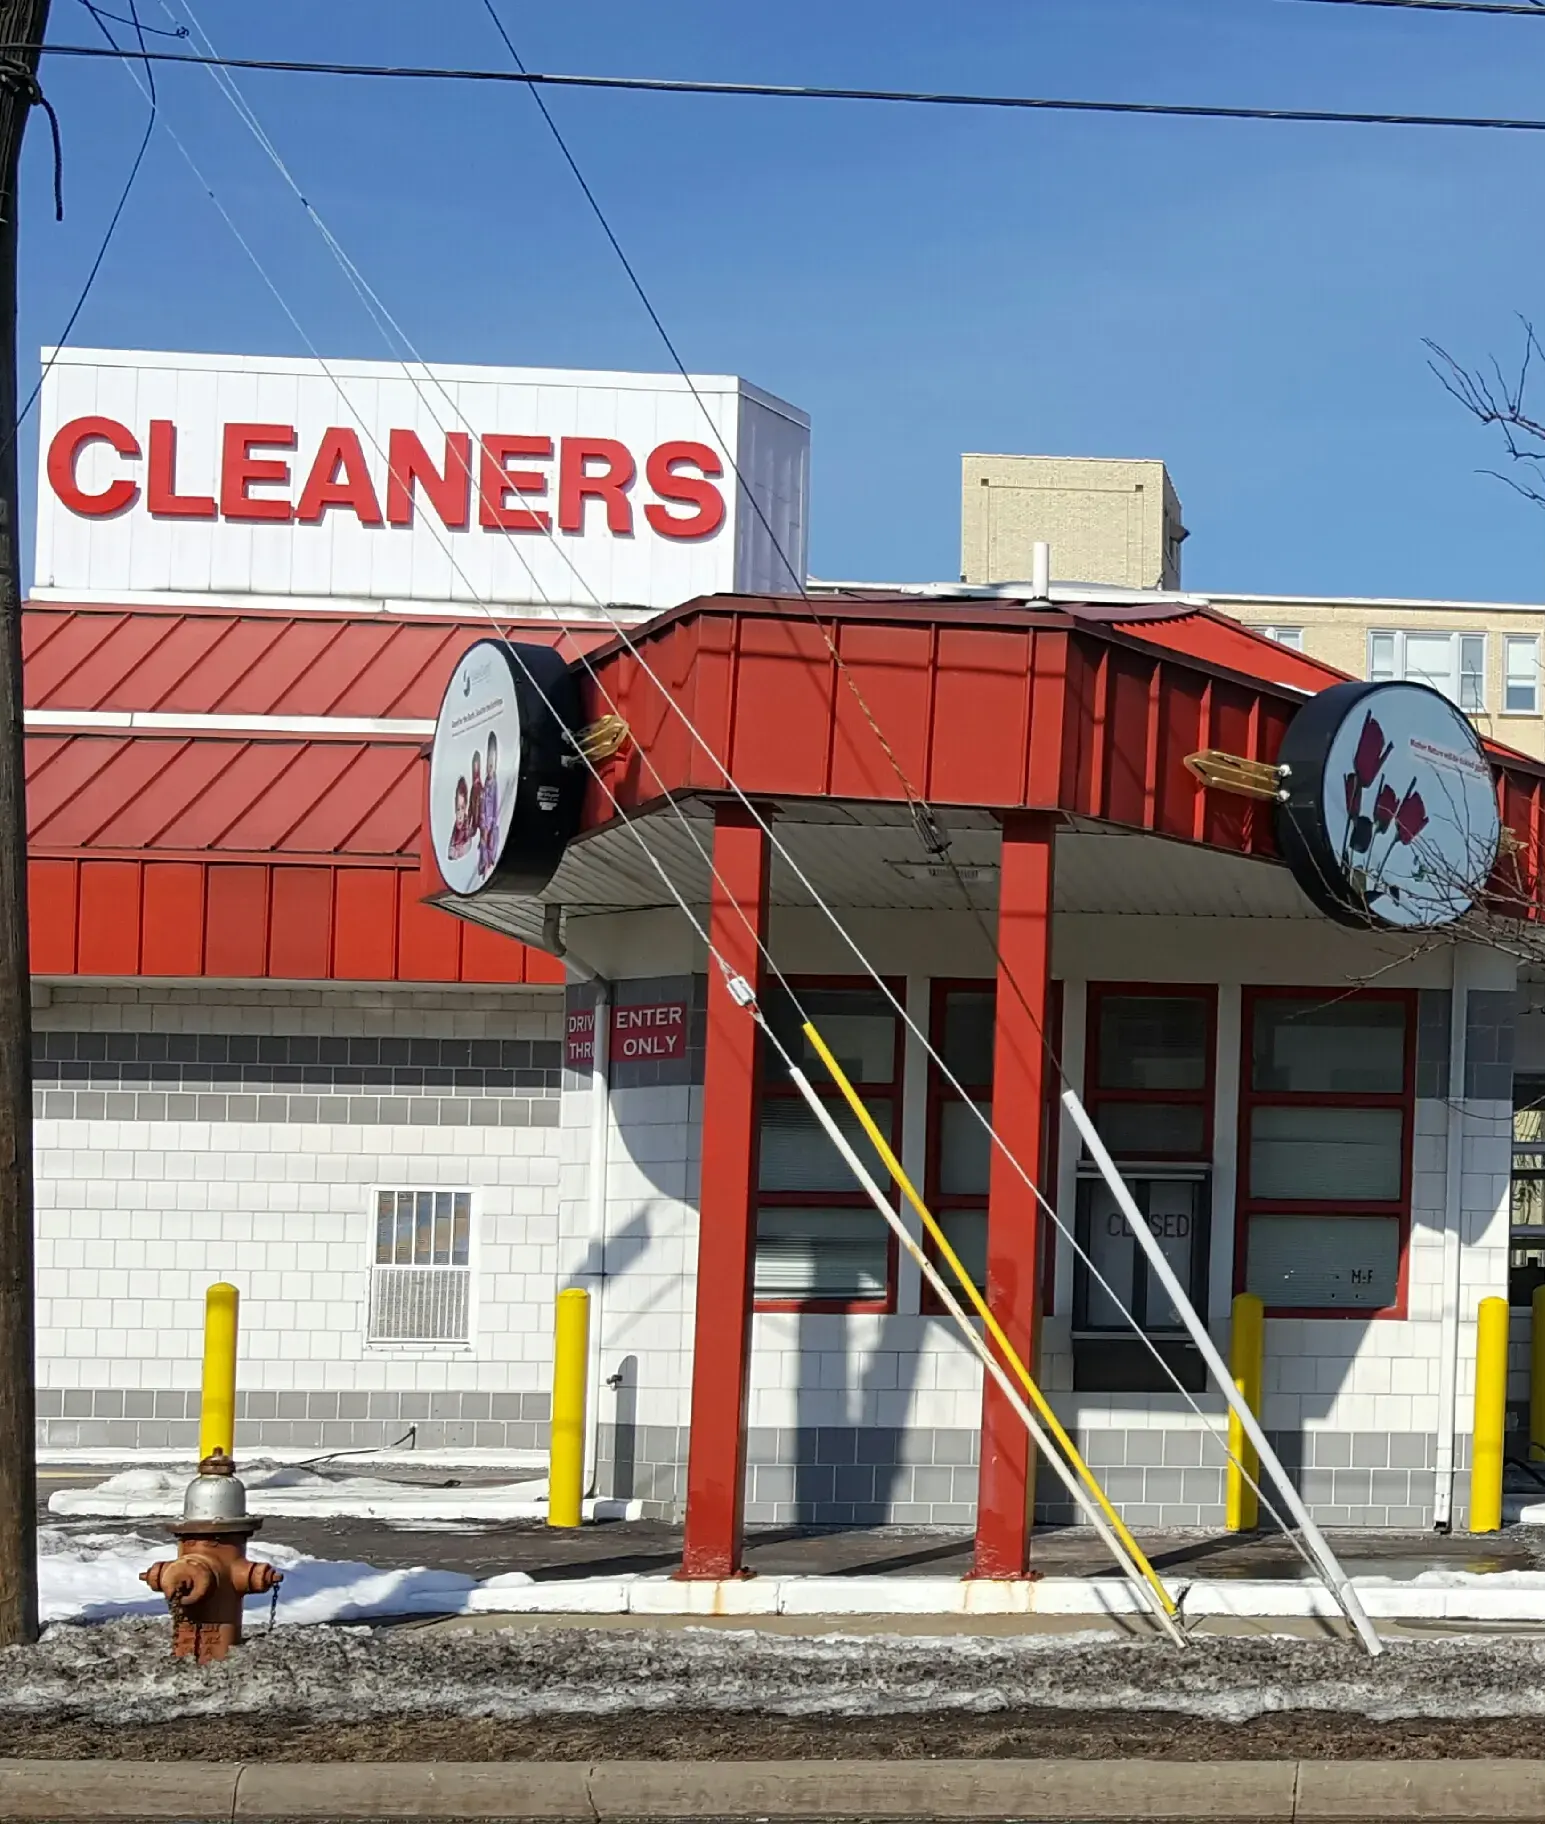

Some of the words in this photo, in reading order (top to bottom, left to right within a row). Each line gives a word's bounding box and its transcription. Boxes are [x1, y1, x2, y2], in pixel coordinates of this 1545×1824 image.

[48, 417, 723, 538] CLEANERS
[569, 1015, 595, 1033] DRIV
[616, 1007, 682, 1029] ENTER
[623, 1035, 677, 1056] ONLY
[1108, 1213, 1189, 1237] CLSED
